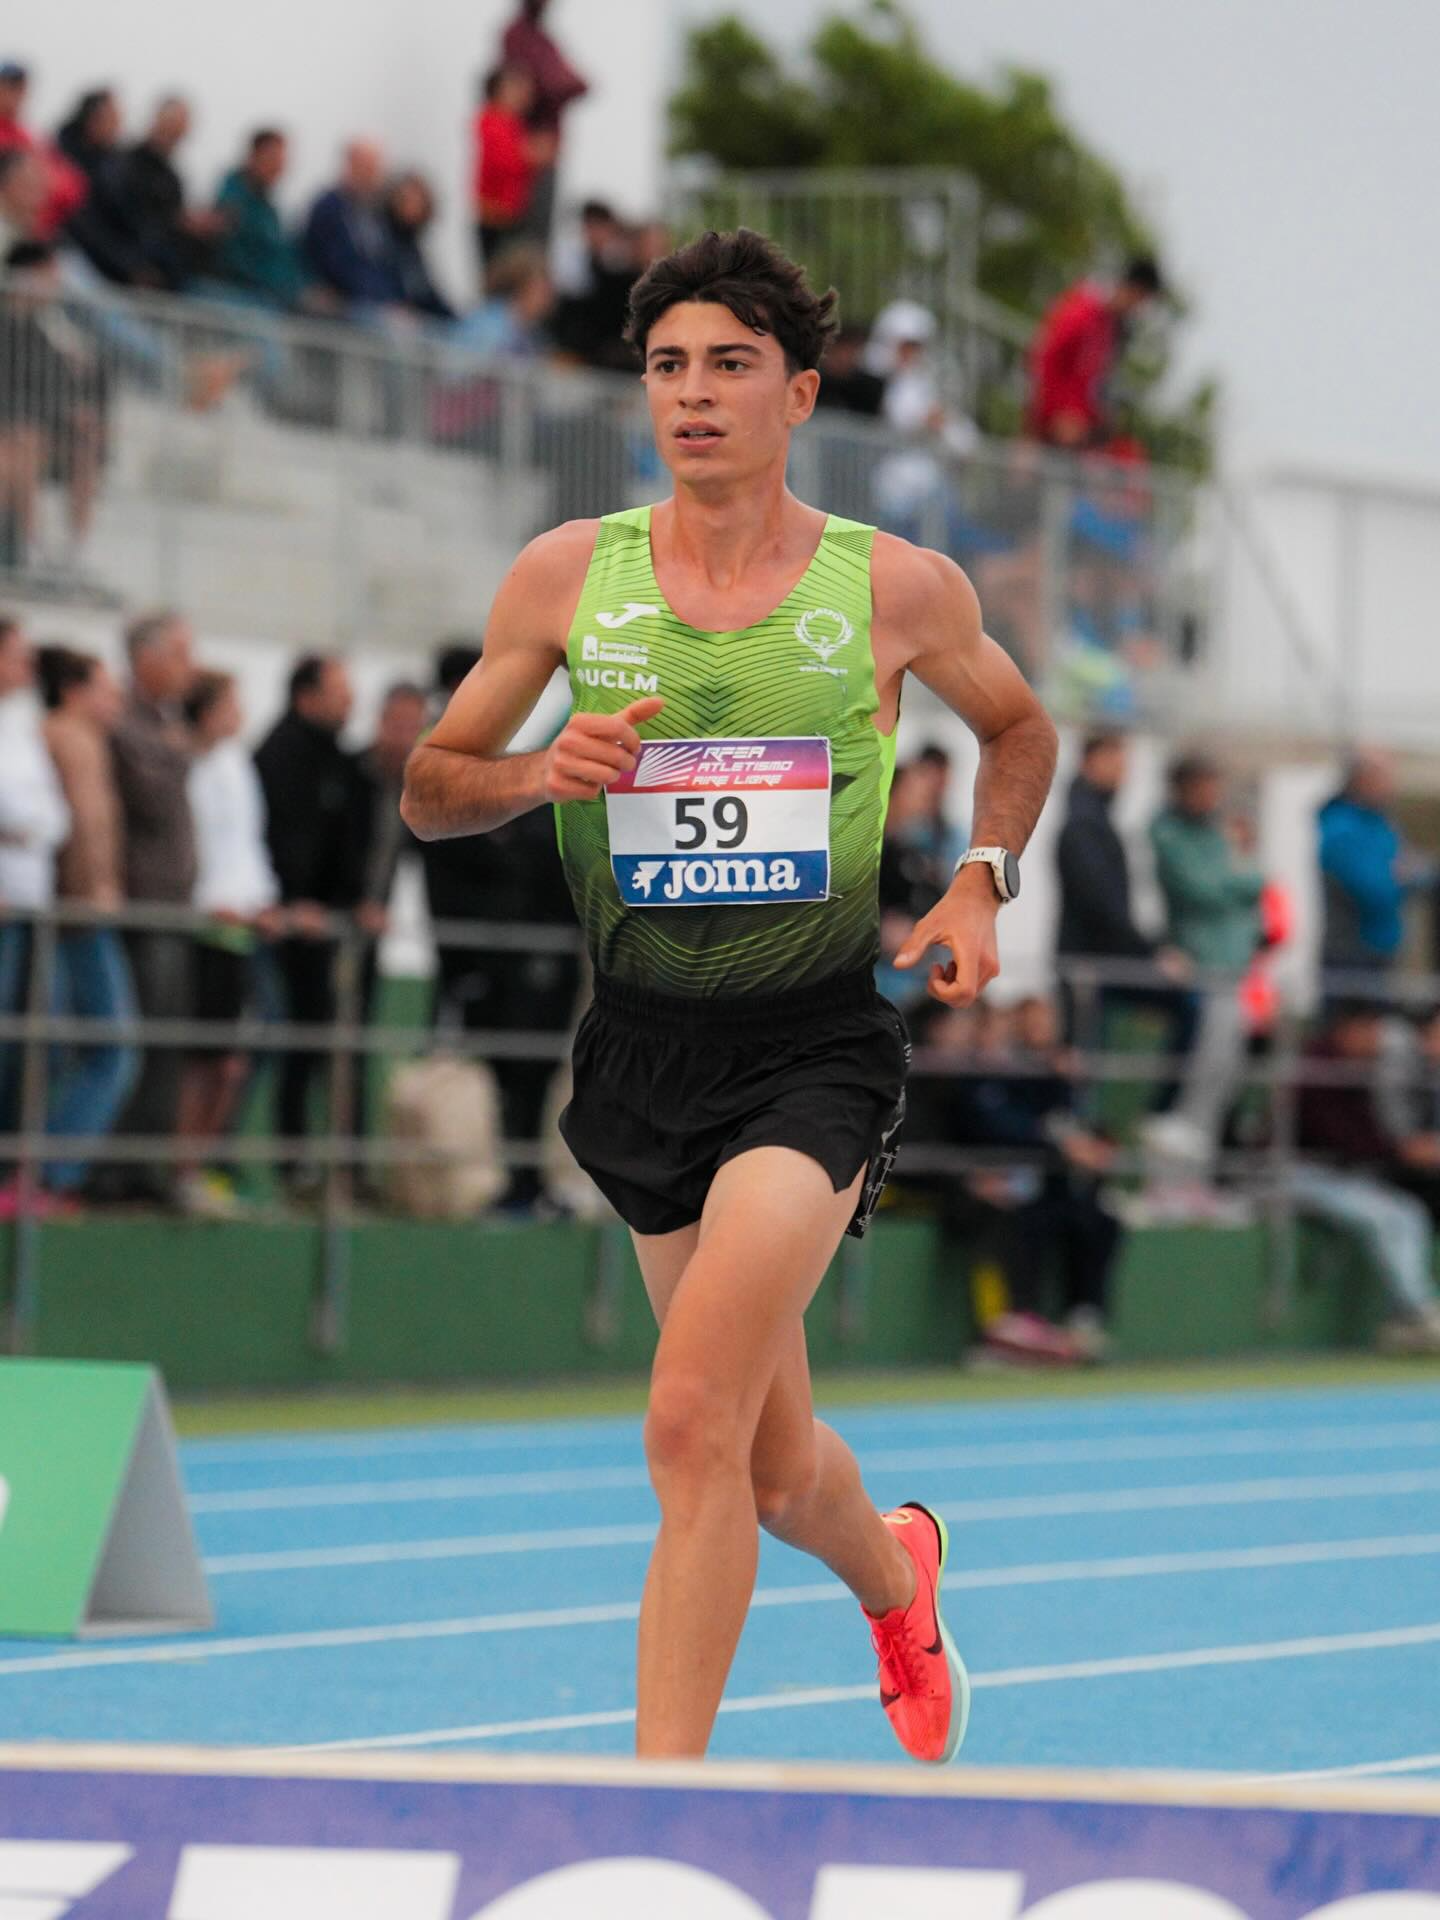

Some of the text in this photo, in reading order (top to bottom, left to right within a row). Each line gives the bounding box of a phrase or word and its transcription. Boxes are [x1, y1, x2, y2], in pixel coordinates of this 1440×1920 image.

[585, 669, 658, 692] UCLM
[702, 746, 767, 761] RFEA
[697, 761, 794, 773] ATLETISMO
[692, 774, 783, 787] AIRE LIBRE
[675, 796, 748, 849] 59
[664, 858, 800, 899] Joma
